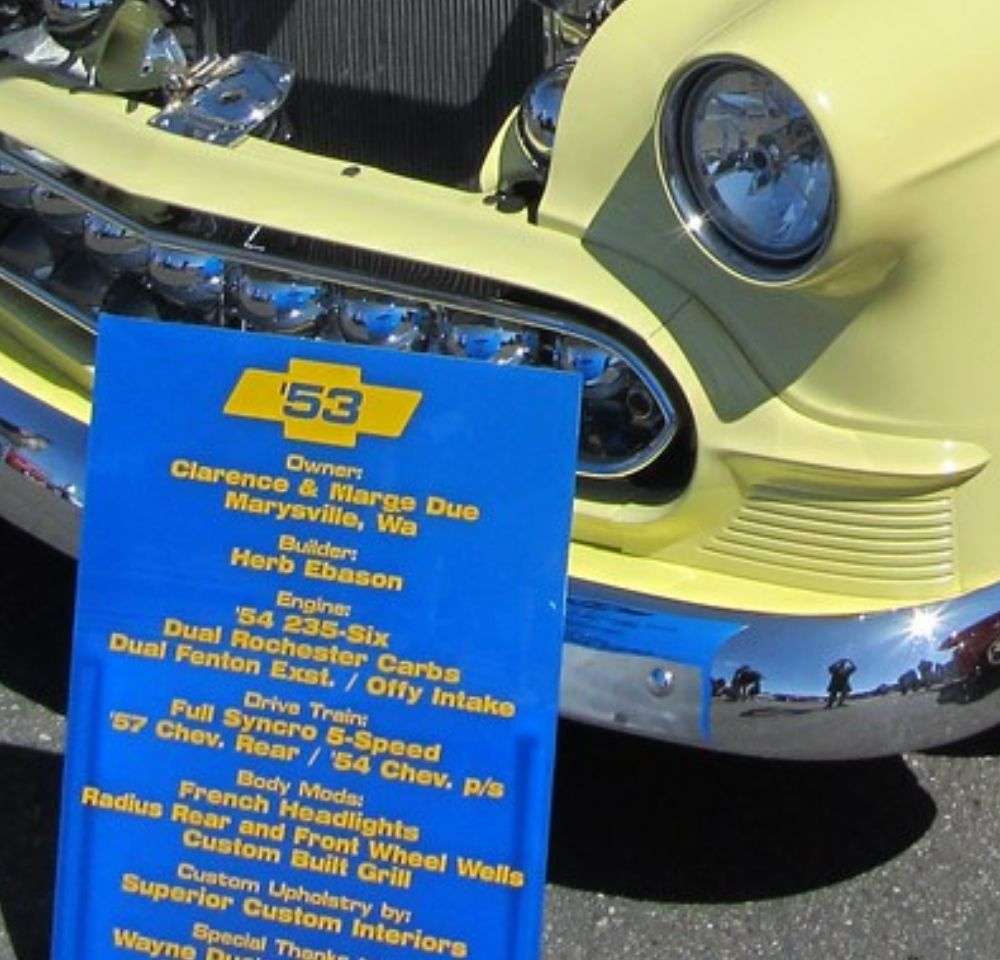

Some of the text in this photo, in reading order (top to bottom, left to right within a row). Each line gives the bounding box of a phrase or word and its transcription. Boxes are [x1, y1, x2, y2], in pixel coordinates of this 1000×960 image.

[282, 382, 364, 425] '53
[286, 454, 363, 479] Owner:
[171, 459, 480, 521] Clarence & Marge Due
[225, 491, 418, 537] Marysville, Wa
[231, 549, 403, 590] Herb Ebason
[279, 534, 357, 561] Builder:
[236, 605, 390, 648] '54 235-Six
[276, 591, 350, 617] Engine:
[164, 618, 461, 684] Dual Rochester Carbs
[110, 633, 167, 658] Dual
[176, 642, 261, 674] Fenton
[270, 659, 335, 688] Exst.
[366, 675, 422, 705] Offy
[432, 688, 516, 717] Intake
[171, 699, 441, 762] Full Syncro 5-Speed
[244, 691, 368, 727] Drive Train:
[111, 712, 147, 732] '57
[156, 720, 224, 749] Chev.
[236, 733, 300, 761] Rear
[331, 749, 371, 774] '54
[380, 759, 453, 789] Chev.
[464, 777, 505, 798] p/s
[178, 781, 420, 841] French Headlights
[236, 770, 364, 807] Body Mods:
[81, 787, 525, 888] Radius Rear and Front Wheel Wells
[183, 829, 413, 889] Custom Built Grill
[122, 874, 468, 958] Superior Custom Interiors
[177, 863, 412, 924] Custom Upholstry by:
[113, 927, 197, 960] Wayne
[193, 923, 267, 951] Special
